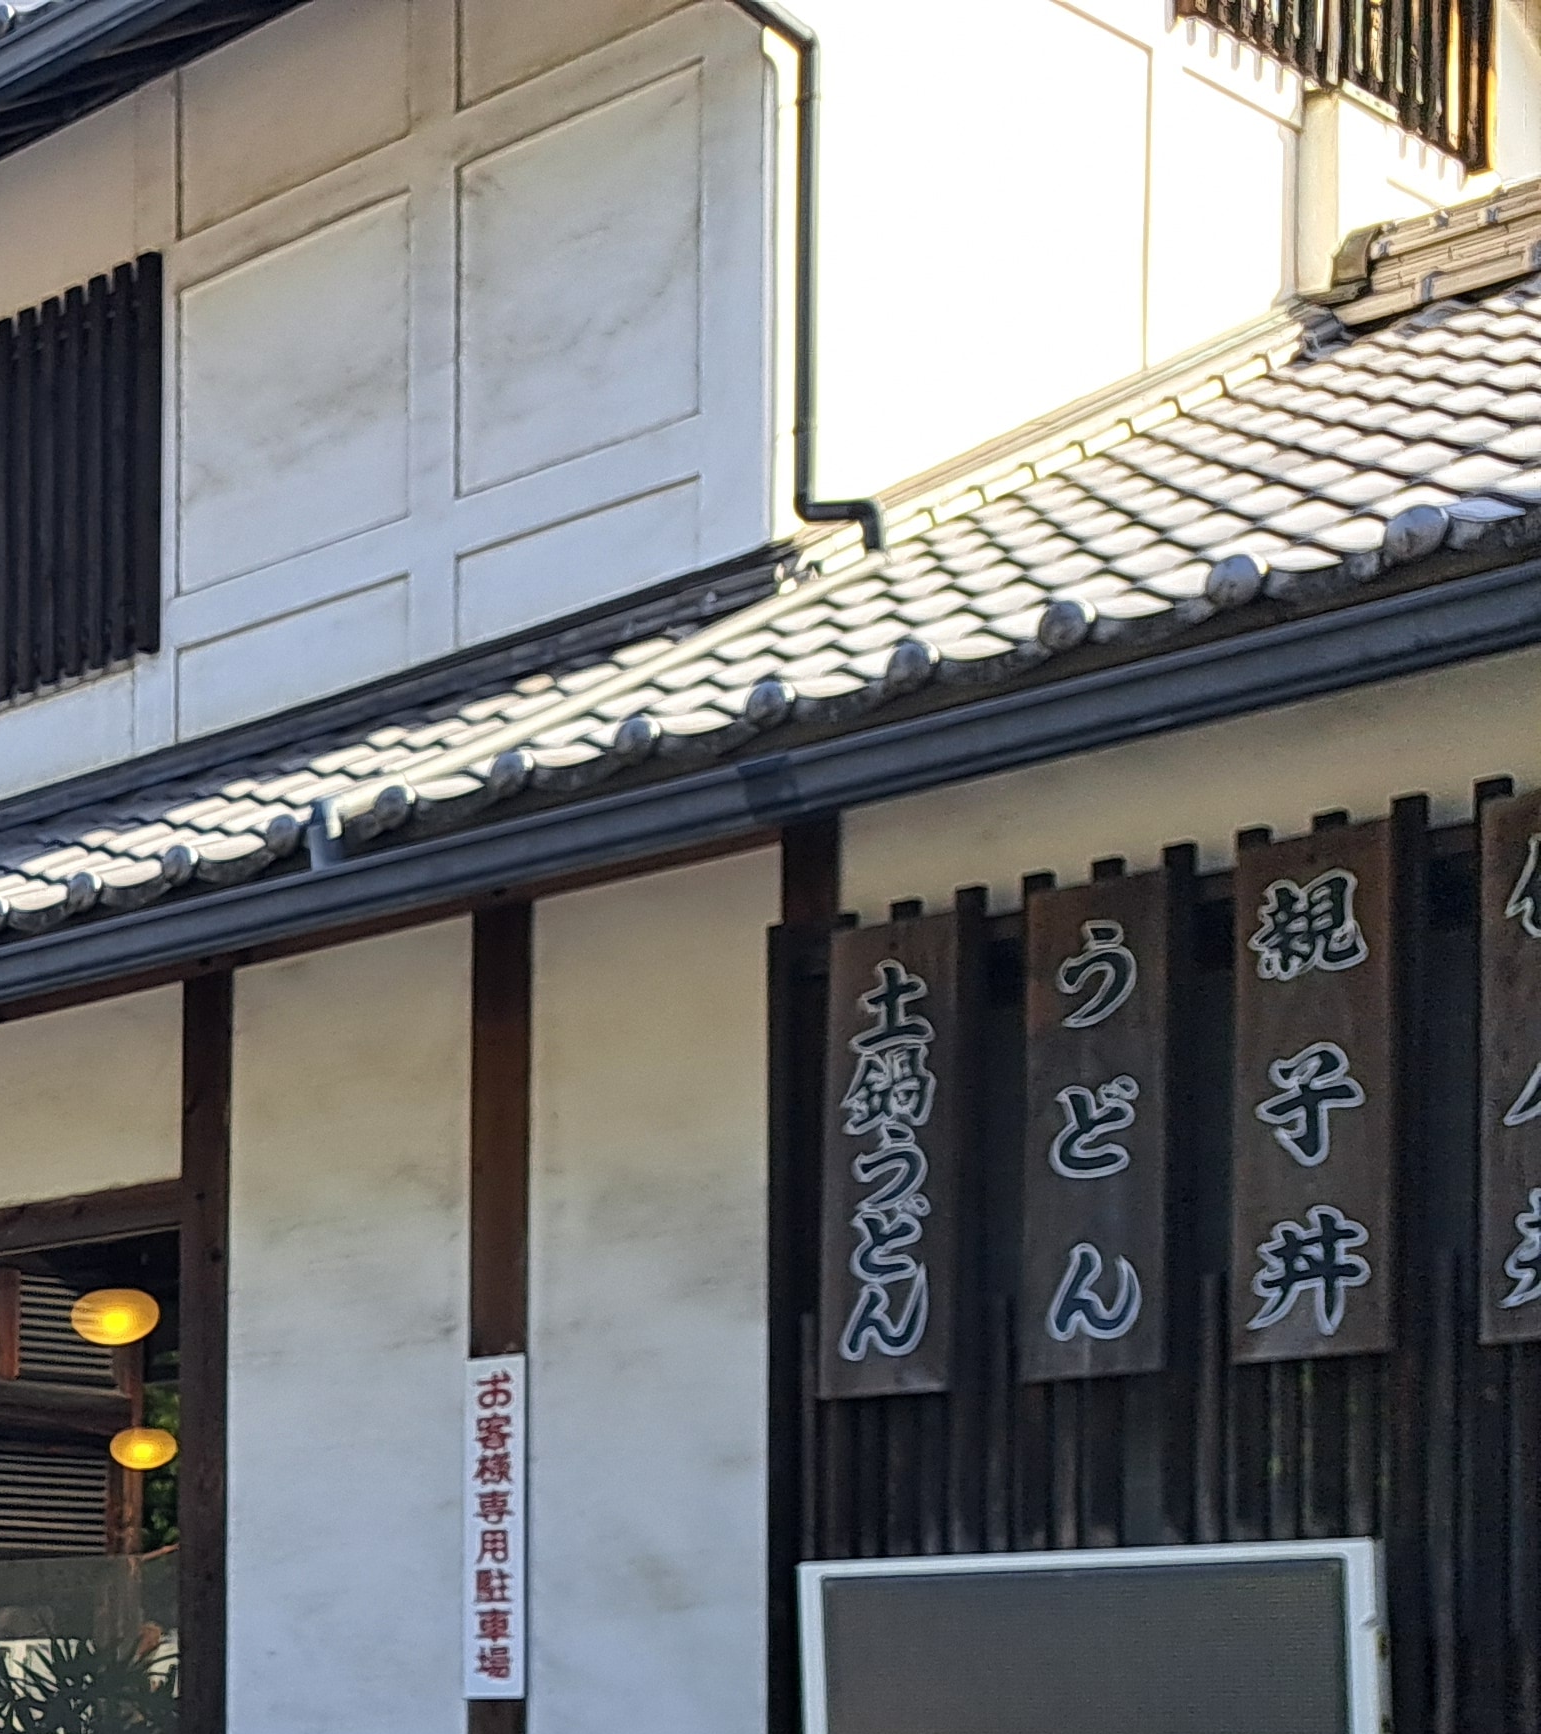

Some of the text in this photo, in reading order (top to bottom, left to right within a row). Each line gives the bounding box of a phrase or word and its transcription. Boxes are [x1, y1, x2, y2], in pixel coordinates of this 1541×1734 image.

[839, 960, 935, 1361] 土鍋うどん
[1046, 920, 1141, 1341] うどん
[1246, 867, 1372, 1336] 親子丼
[474, 1369, 514, 1680] お客様専用駐車場
